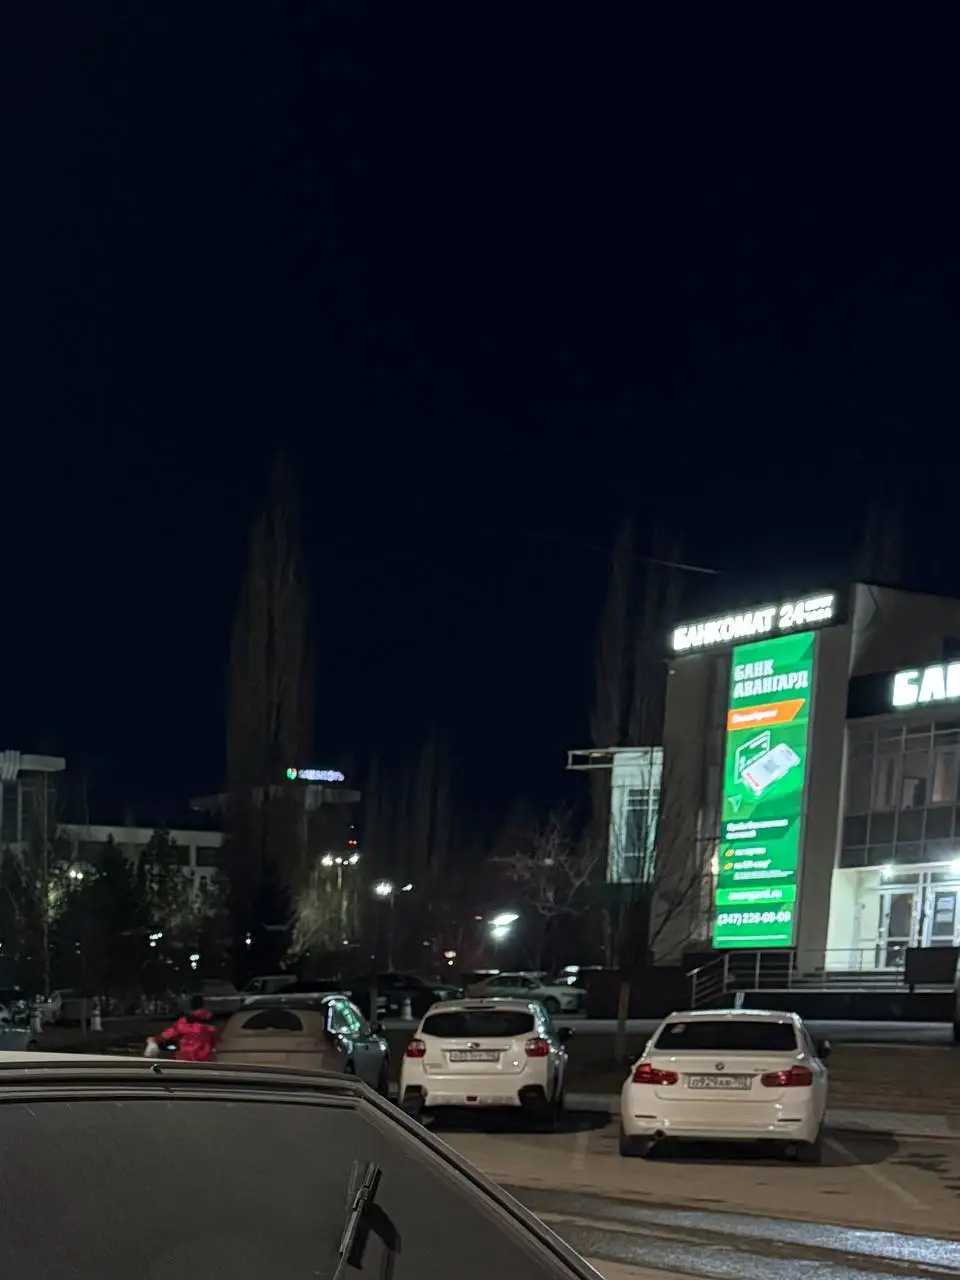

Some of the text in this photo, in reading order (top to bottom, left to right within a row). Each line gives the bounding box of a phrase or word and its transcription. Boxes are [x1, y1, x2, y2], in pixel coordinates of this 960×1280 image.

[673, 607, 777, 651] БАНКОМАТ
[778, 602, 805, 629] 24
[733, 670, 809, 699] АВАНГАРД
[734, 659, 774, 682] БАНК
